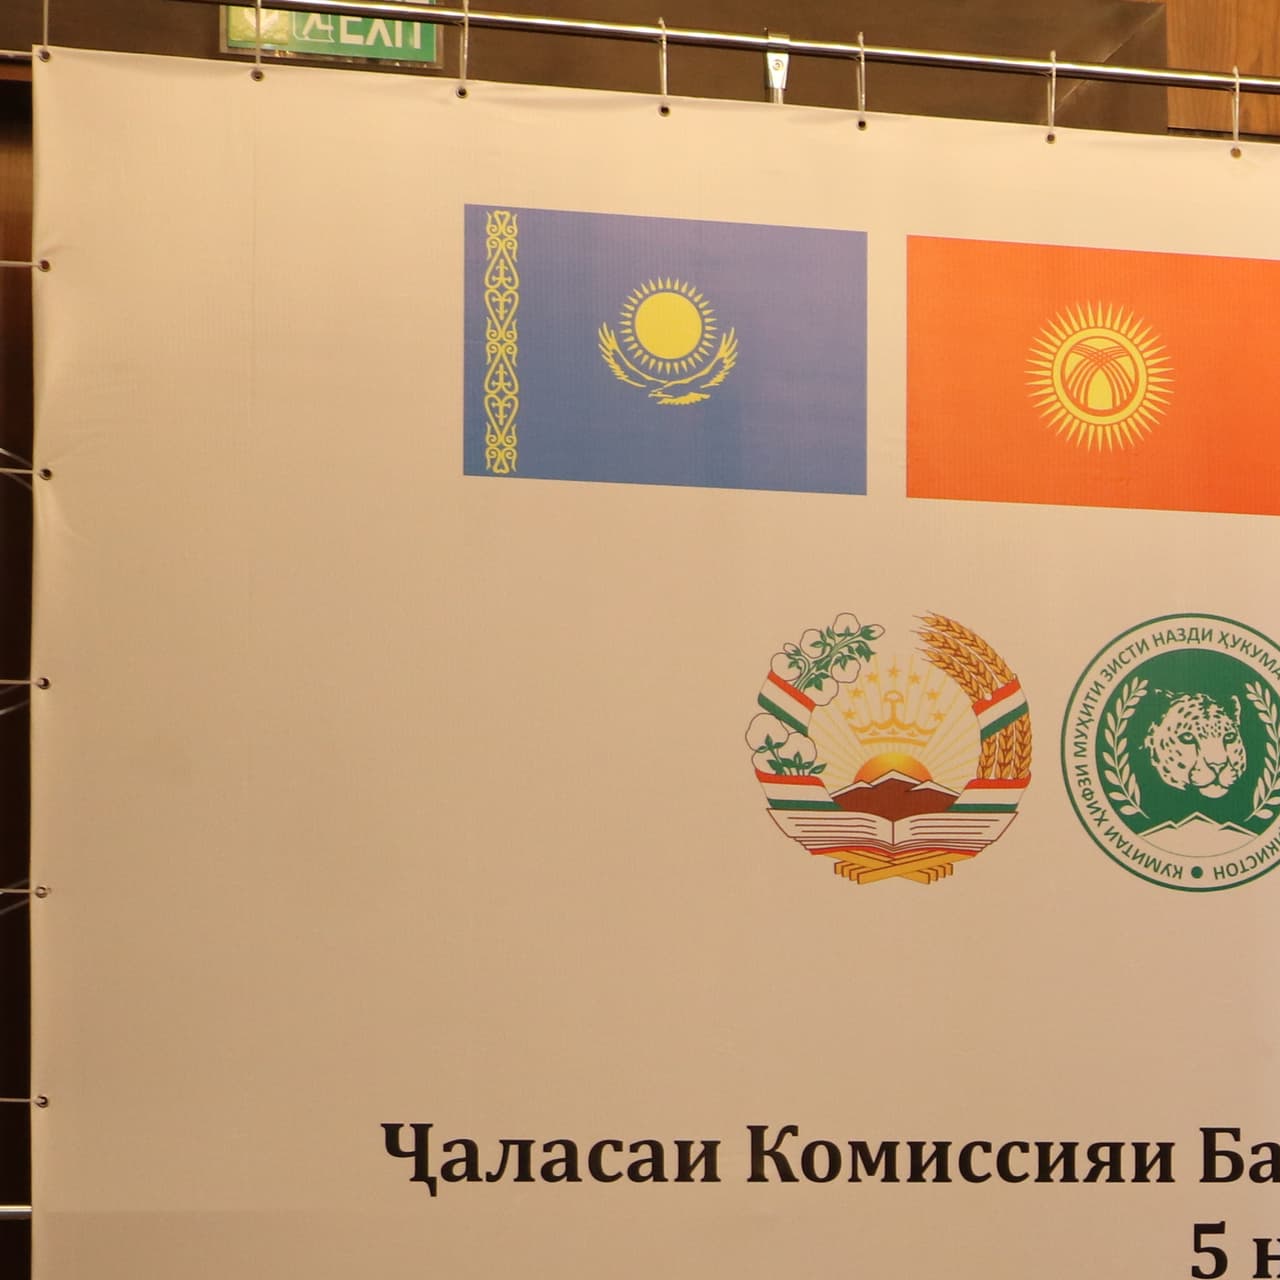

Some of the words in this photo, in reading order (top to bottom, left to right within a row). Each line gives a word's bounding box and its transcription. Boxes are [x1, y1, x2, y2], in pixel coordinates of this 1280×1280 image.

[1100, 638, 1150, 682] ЗИСТИ
[1152, 627, 1214, 648] НАЗДИ
[1104, 826, 1183, 879] КУМИТАИ
[381, 1122, 722, 1198] Ҷаласаи
[746, 1124, 1176, 1185] Комиссияи
[1191, 1220, 1228, 1280] 5
